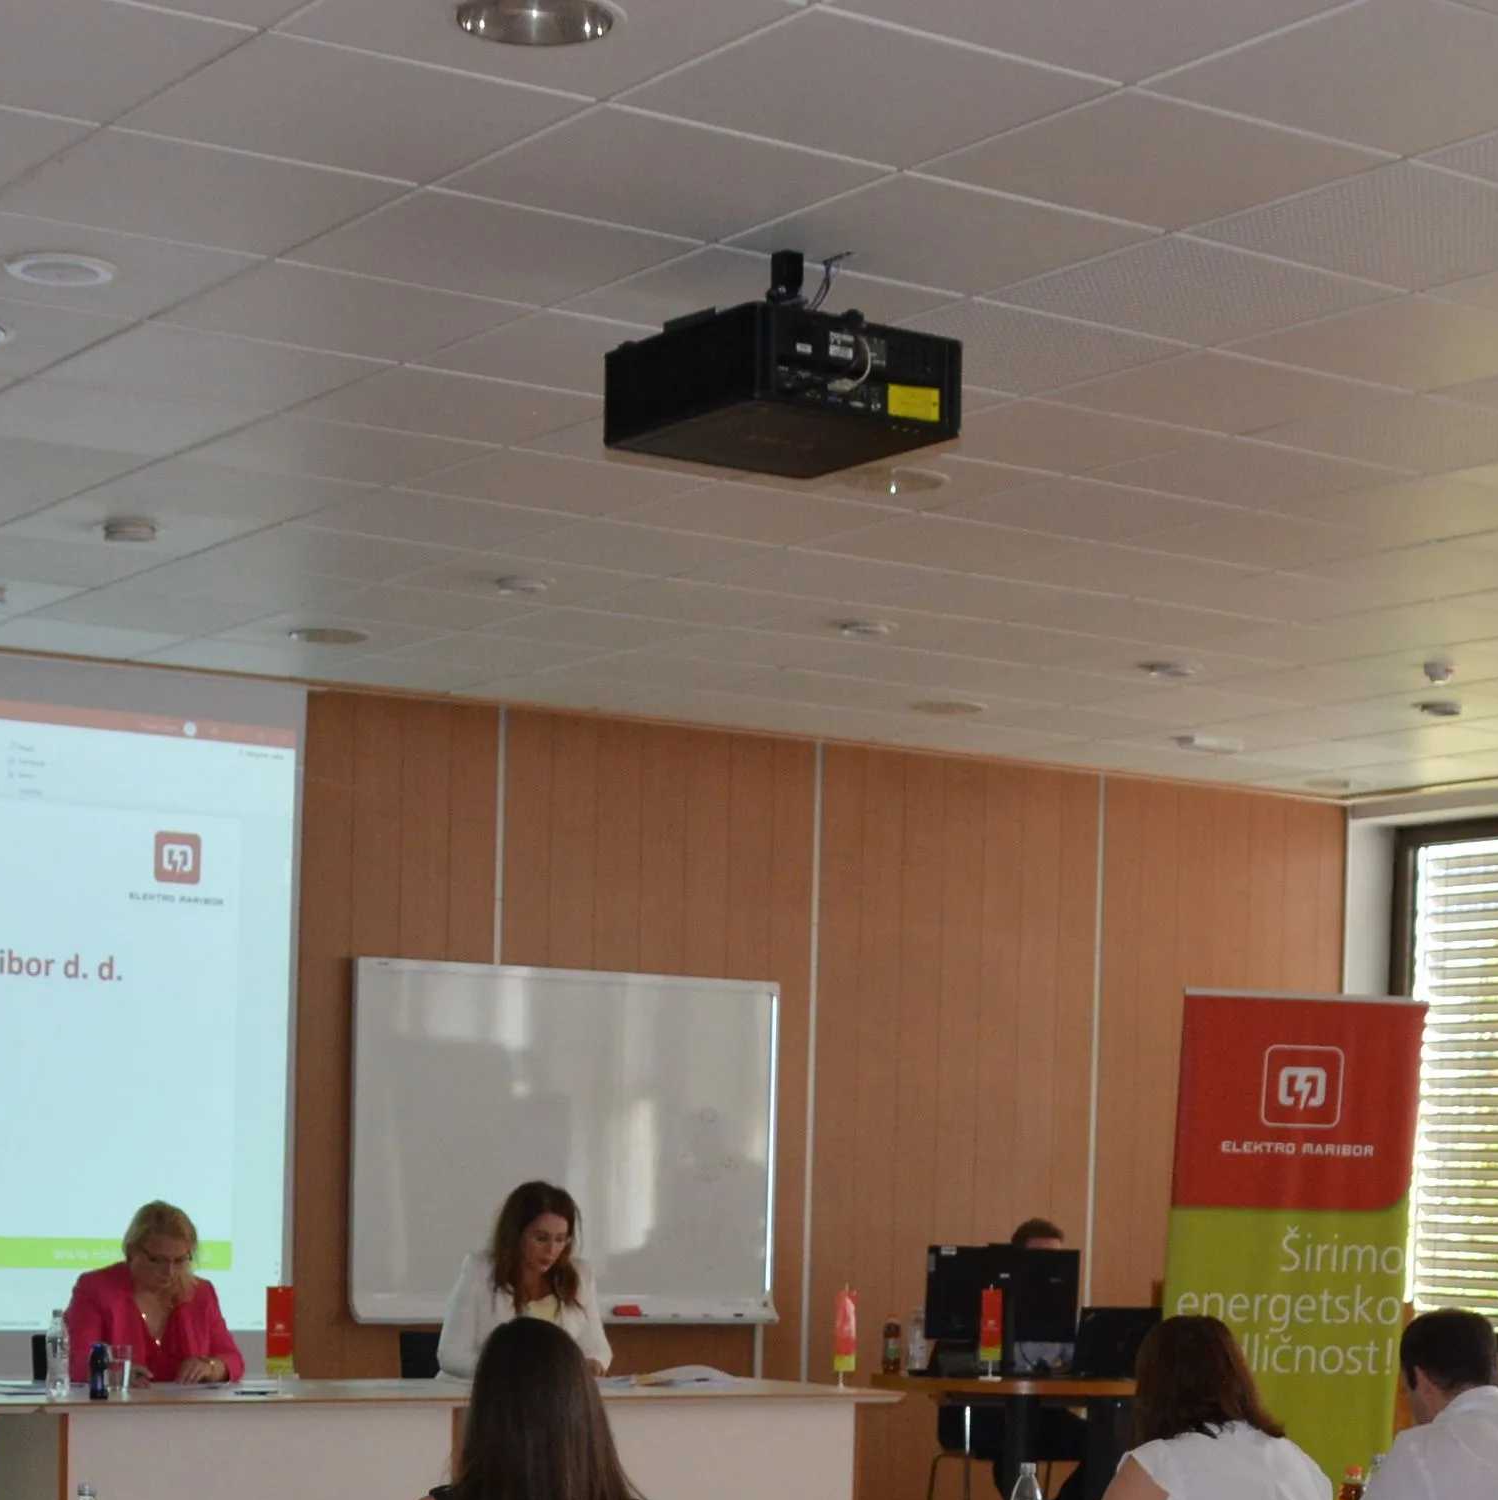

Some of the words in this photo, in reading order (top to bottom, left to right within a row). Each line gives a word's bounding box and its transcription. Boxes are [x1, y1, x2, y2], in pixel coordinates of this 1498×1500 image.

[63, 954, 88, 979] d.
[98, 956, 123, 982] d.
[1221, 1140, 1296, 1155] ELEKTRO
[1302, 1142, 1374, 1157] MARIBOR
[1280, 1226, 1403, 1274] Širimo
[1177, 1285, 1401, 1333] energetsko
[1242, 1332, 1394, 1374] ličnost!
